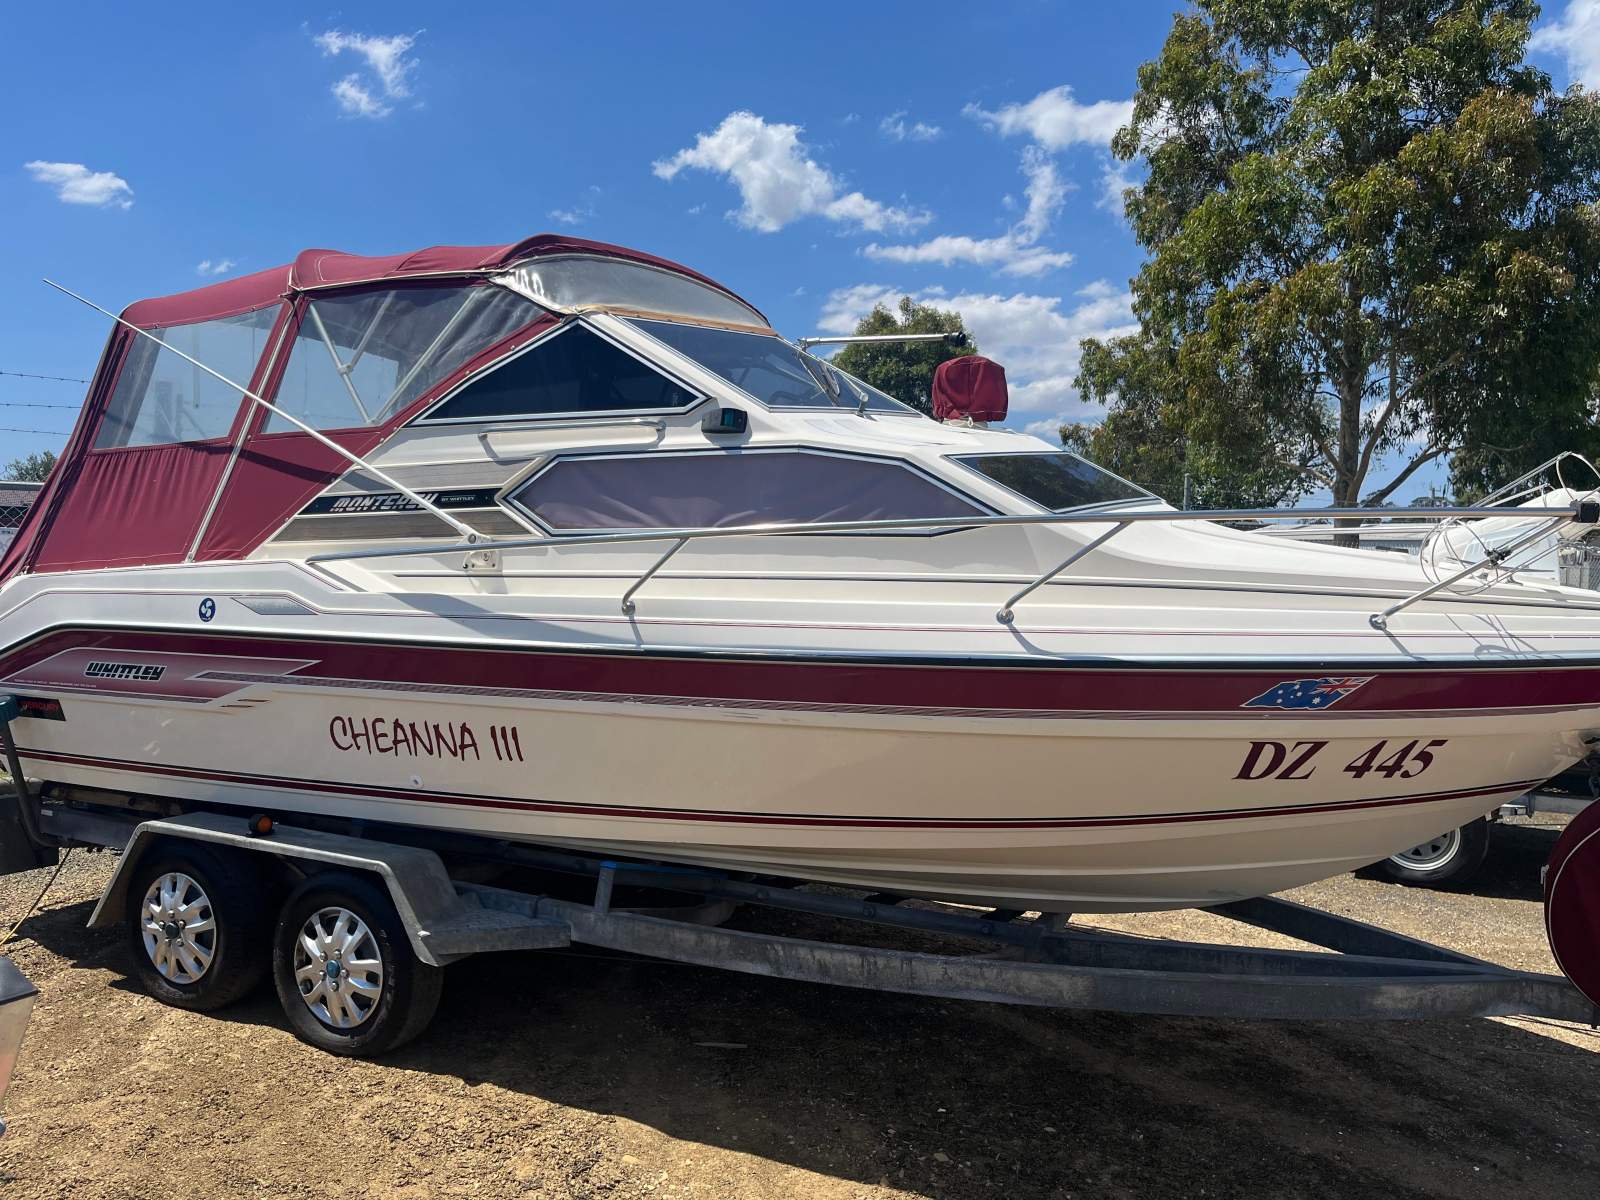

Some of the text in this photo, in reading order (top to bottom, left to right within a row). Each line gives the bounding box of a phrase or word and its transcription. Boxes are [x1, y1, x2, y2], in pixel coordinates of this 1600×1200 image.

[85, 662, 166, 681] WHITTLEY
[329, 715, 524, 762] CHEANNA III
[1232, 739, 1449, 780] DZ 445
